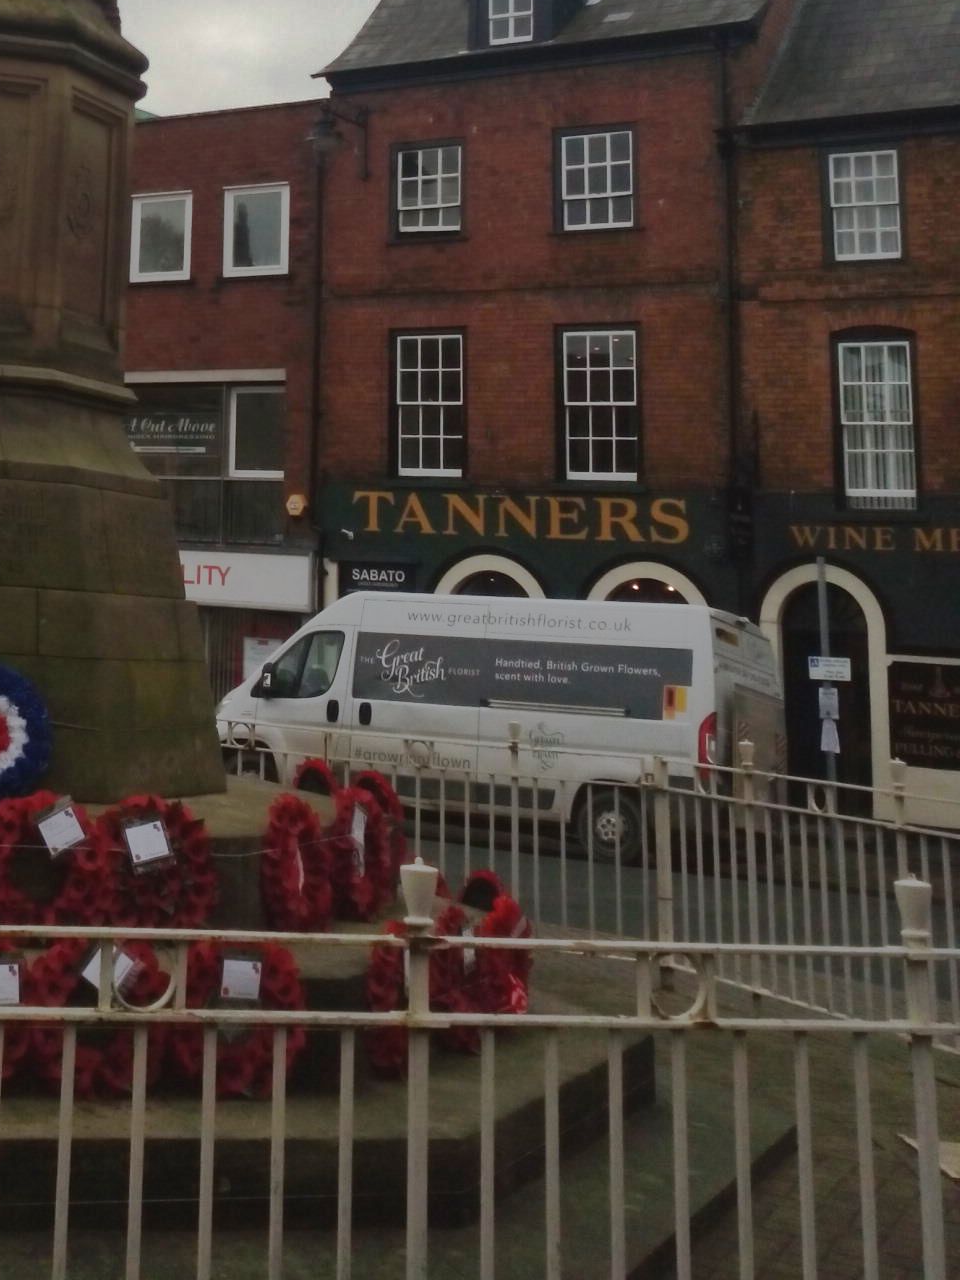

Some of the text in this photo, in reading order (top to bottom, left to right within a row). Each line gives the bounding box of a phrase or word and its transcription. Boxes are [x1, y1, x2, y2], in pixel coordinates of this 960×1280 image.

[168, 417, 216, 432] Above
[352, 490, 690, 545] TANNERS
[790, 525, 897, 551] WINE
[352, 568, 406, 583] SABATO
[407, 610, 632, 633] www.greatbritishflorist.co.uk
[360, 640, 424, 680] THE Great
[546, 660, 578, 672] British
[581, 662, 615, 674] Grown
[618, 664, 661, 678] Flowers,
[392, 657, 481, 697] British FLORIST
[495, 671, 570, 685] scent with love.
